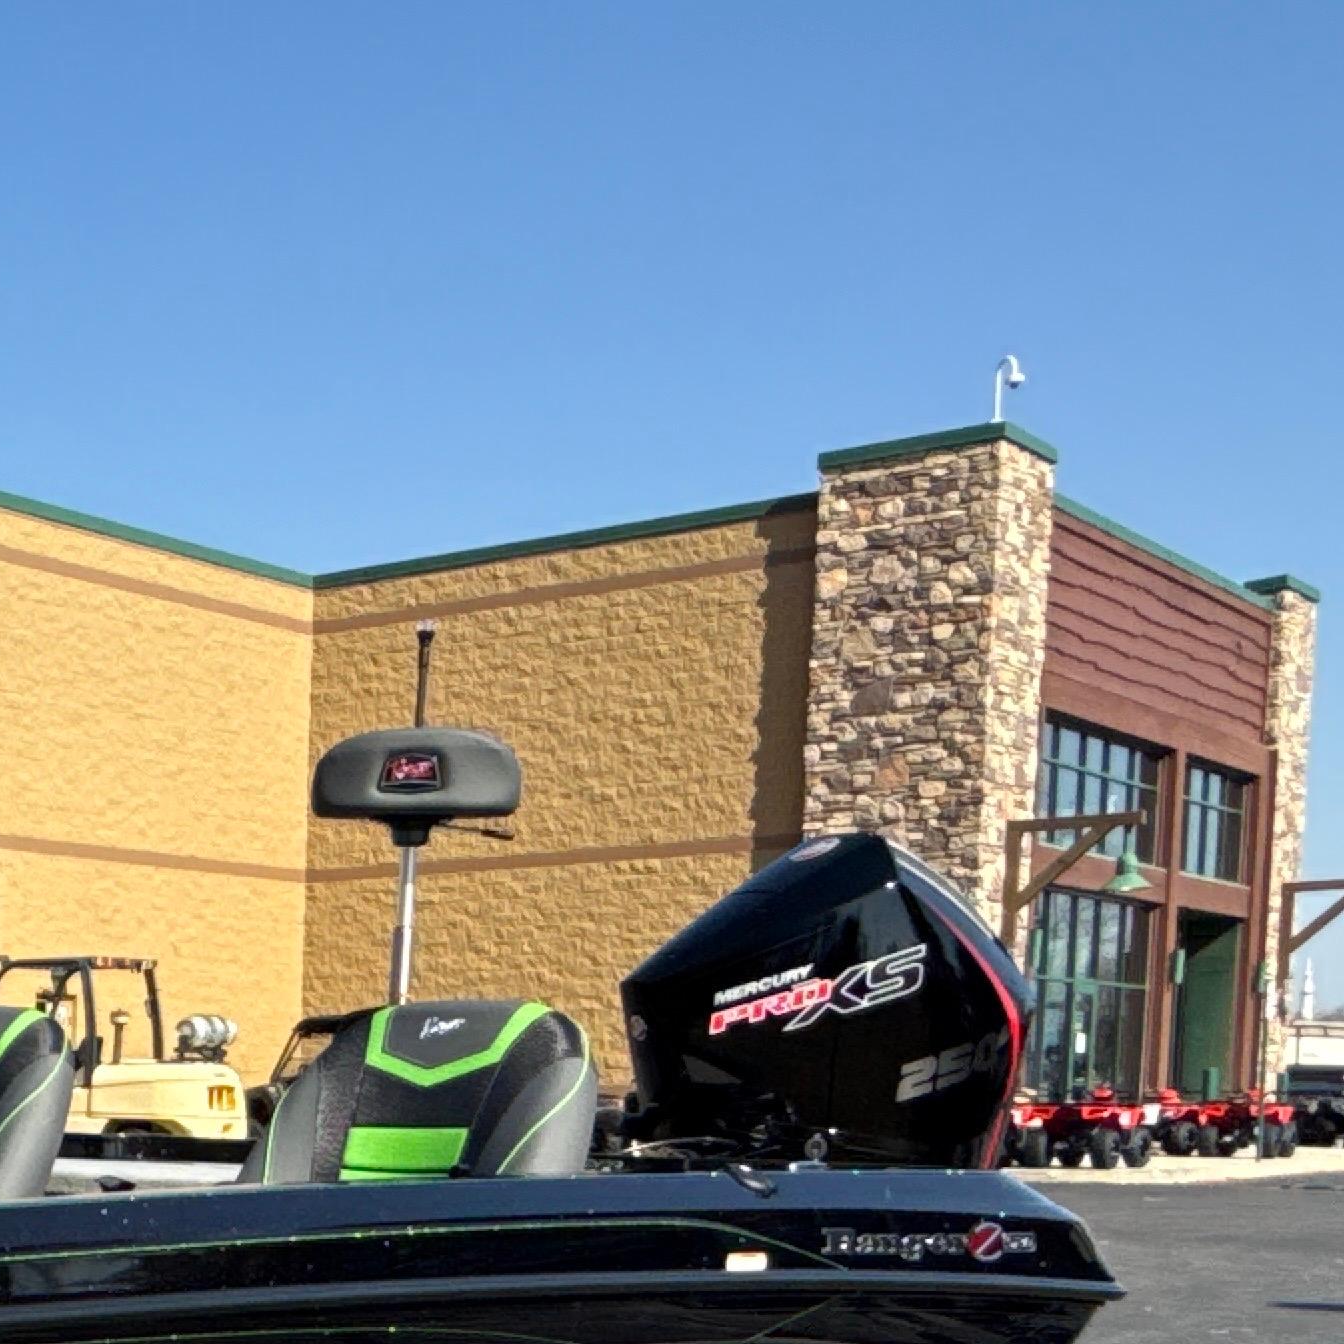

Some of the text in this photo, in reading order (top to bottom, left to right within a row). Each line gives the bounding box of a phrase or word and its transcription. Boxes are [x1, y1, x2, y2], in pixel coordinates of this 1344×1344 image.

[713, 963, 815, 1007] MERCURY
[894, 1031, 1000, 1103] 250
[820, 1226, 968, 1262] Ranger
